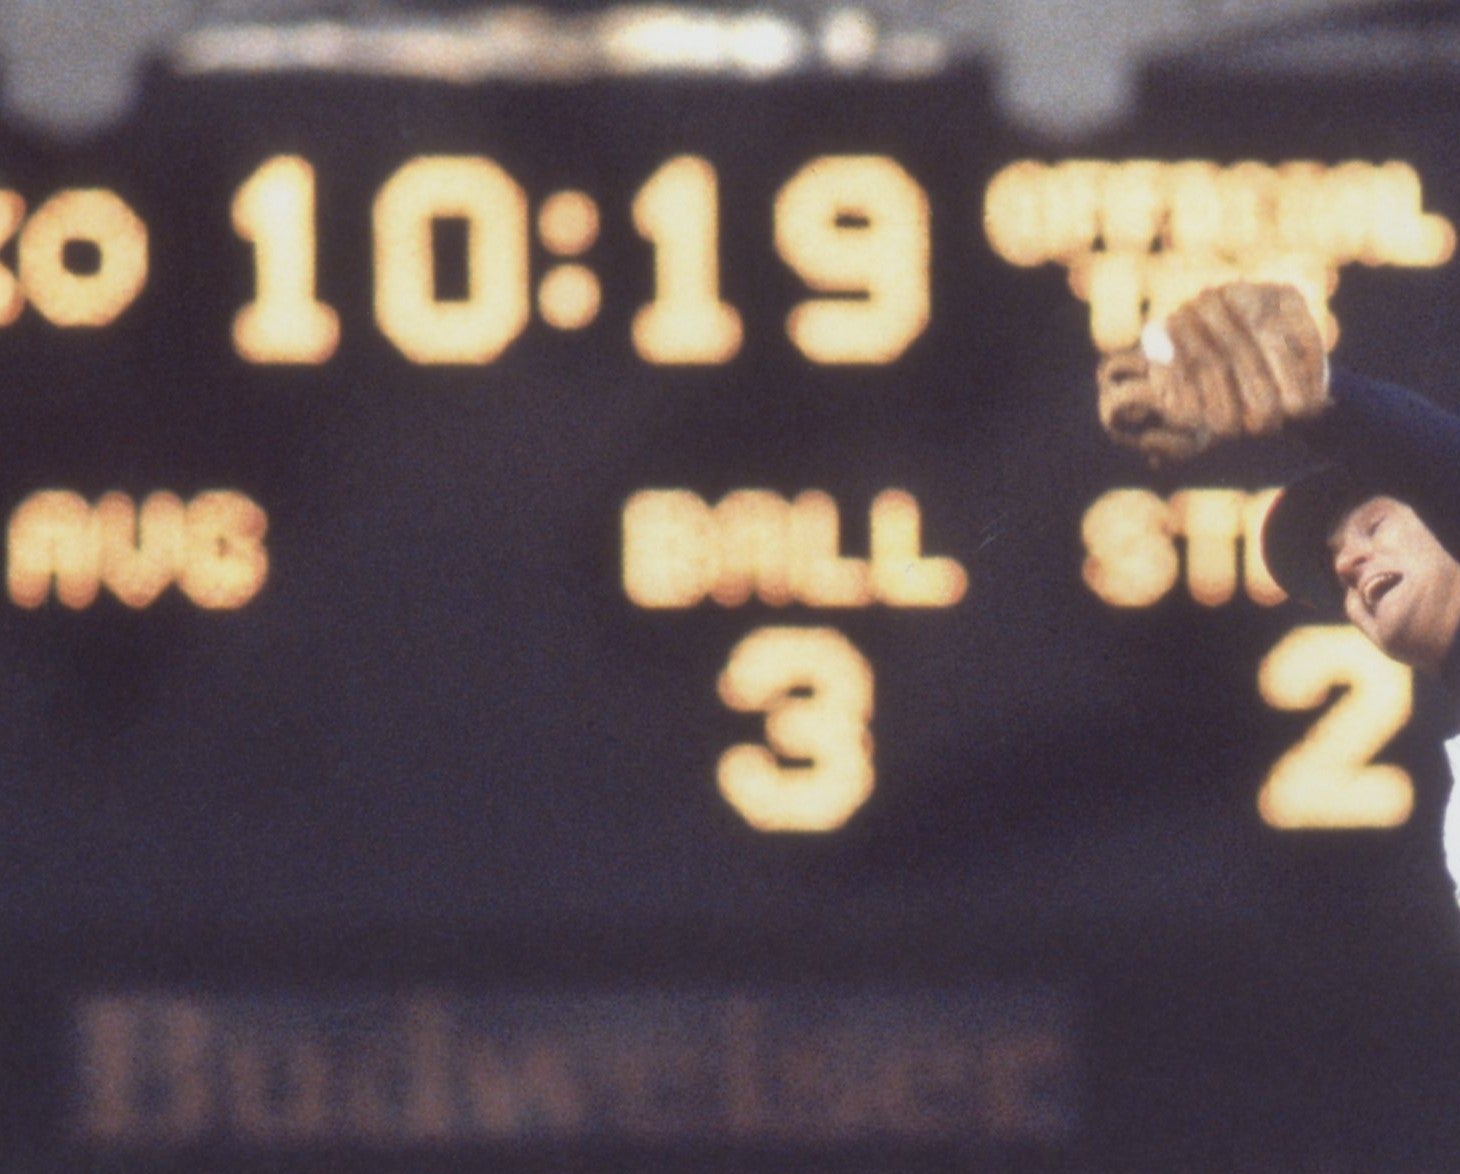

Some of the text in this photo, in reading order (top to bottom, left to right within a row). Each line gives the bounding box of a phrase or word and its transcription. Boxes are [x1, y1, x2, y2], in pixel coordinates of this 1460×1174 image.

[232, 154, 932, 365] 10:19
[622, 487, 969, 609] BALL
[717, 624, 1415, 833] 3 2
